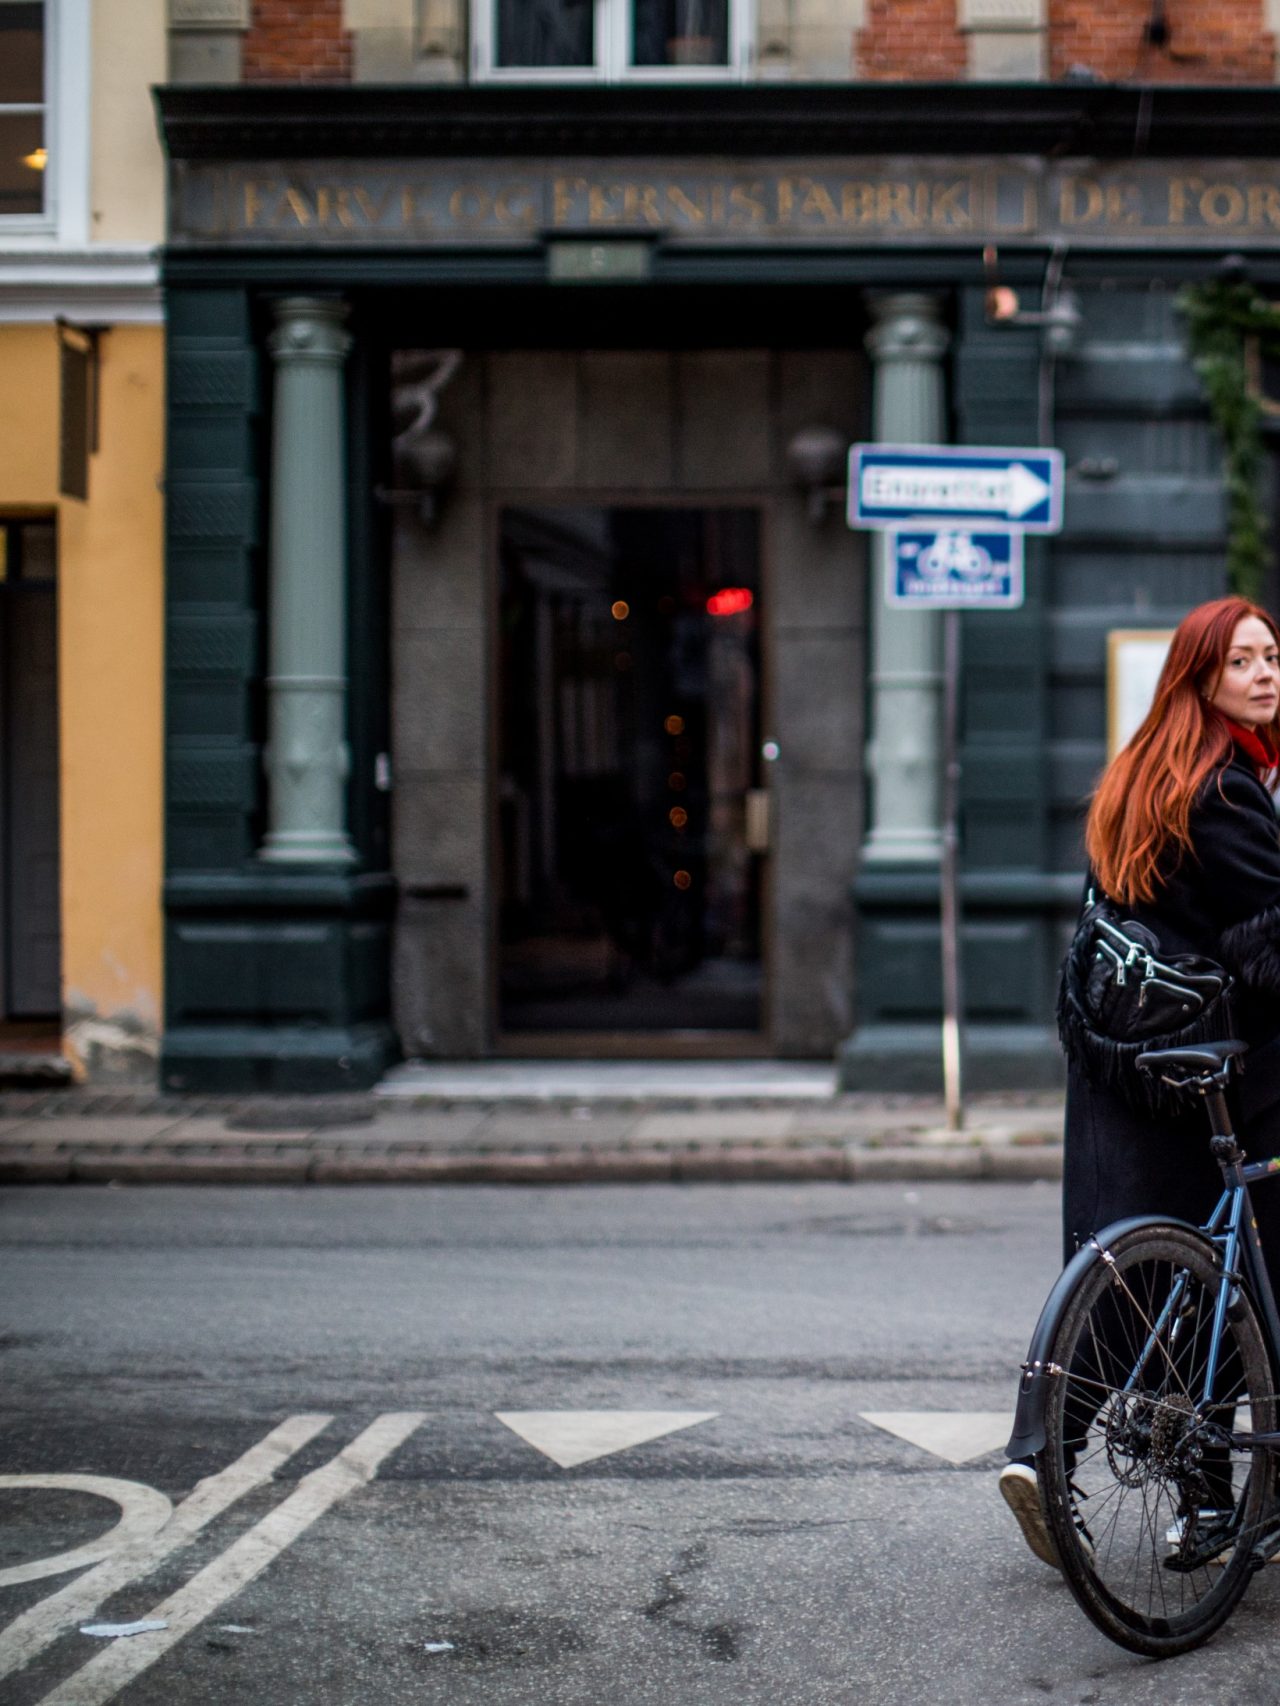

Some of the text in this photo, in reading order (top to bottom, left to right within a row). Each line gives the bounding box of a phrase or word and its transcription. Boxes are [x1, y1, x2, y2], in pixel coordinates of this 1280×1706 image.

[243, 179, 433, 229] FARVE
[447, 184, 537, 229] OG
[1059, 177, 1142, 226] DE
